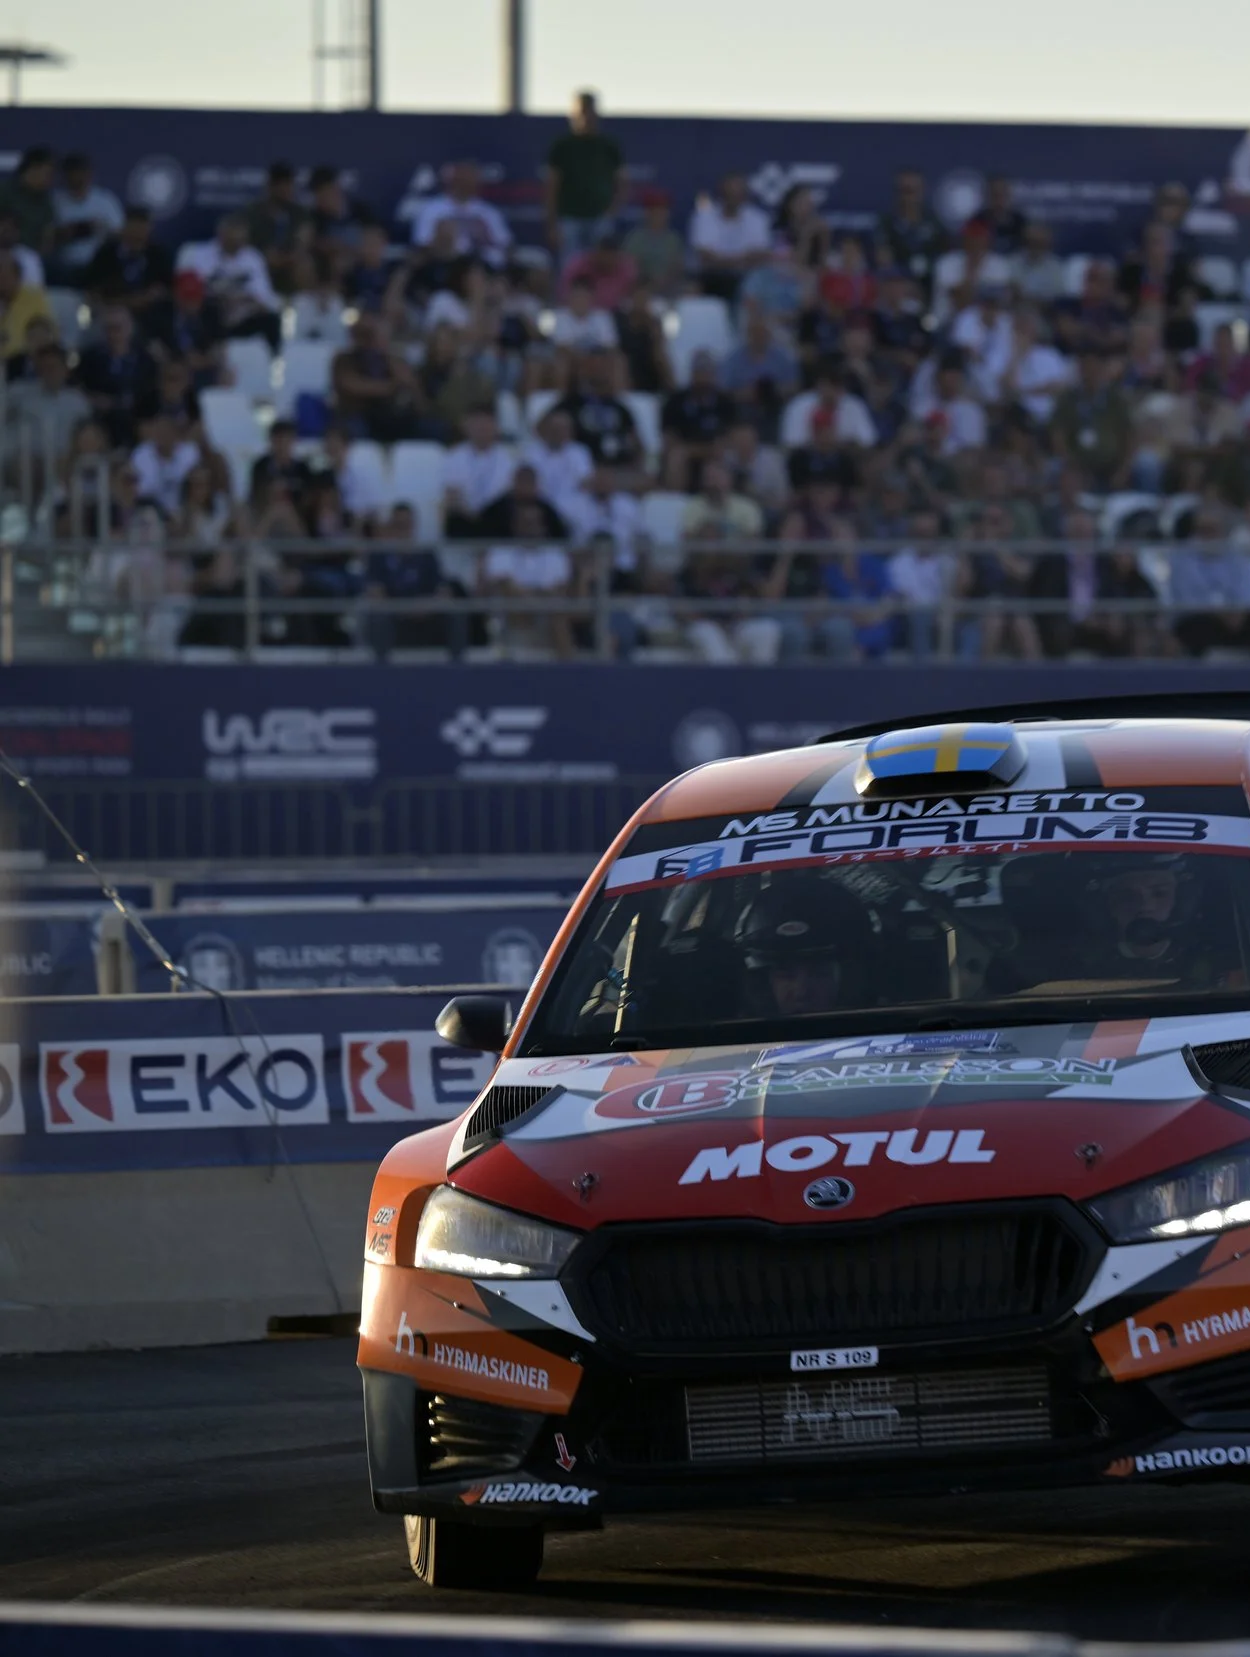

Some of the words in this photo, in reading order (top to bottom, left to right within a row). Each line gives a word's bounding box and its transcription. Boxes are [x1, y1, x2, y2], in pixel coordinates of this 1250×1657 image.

[202, 707, 375, 753] WRC
[717, 811, 799, 839] MS
[804, 792, 1146, 827] MUNARETTO
[739, 815, 1208, 863] FORUM8
[349, 942, 444, 967] REPUBLIC
[129, 1048, 317, 1114] EKO
[737, 1057, 1118, 1088] CARLSSON
[678, 1128, 996, 1185] MOTUL
[434, 1342, 549, 1391] HYRMASKINER
[796, 1354, 820, 1367] NR
[826, 1352, 837, 1365] S
[844, 1350, 872, 1364] 109
